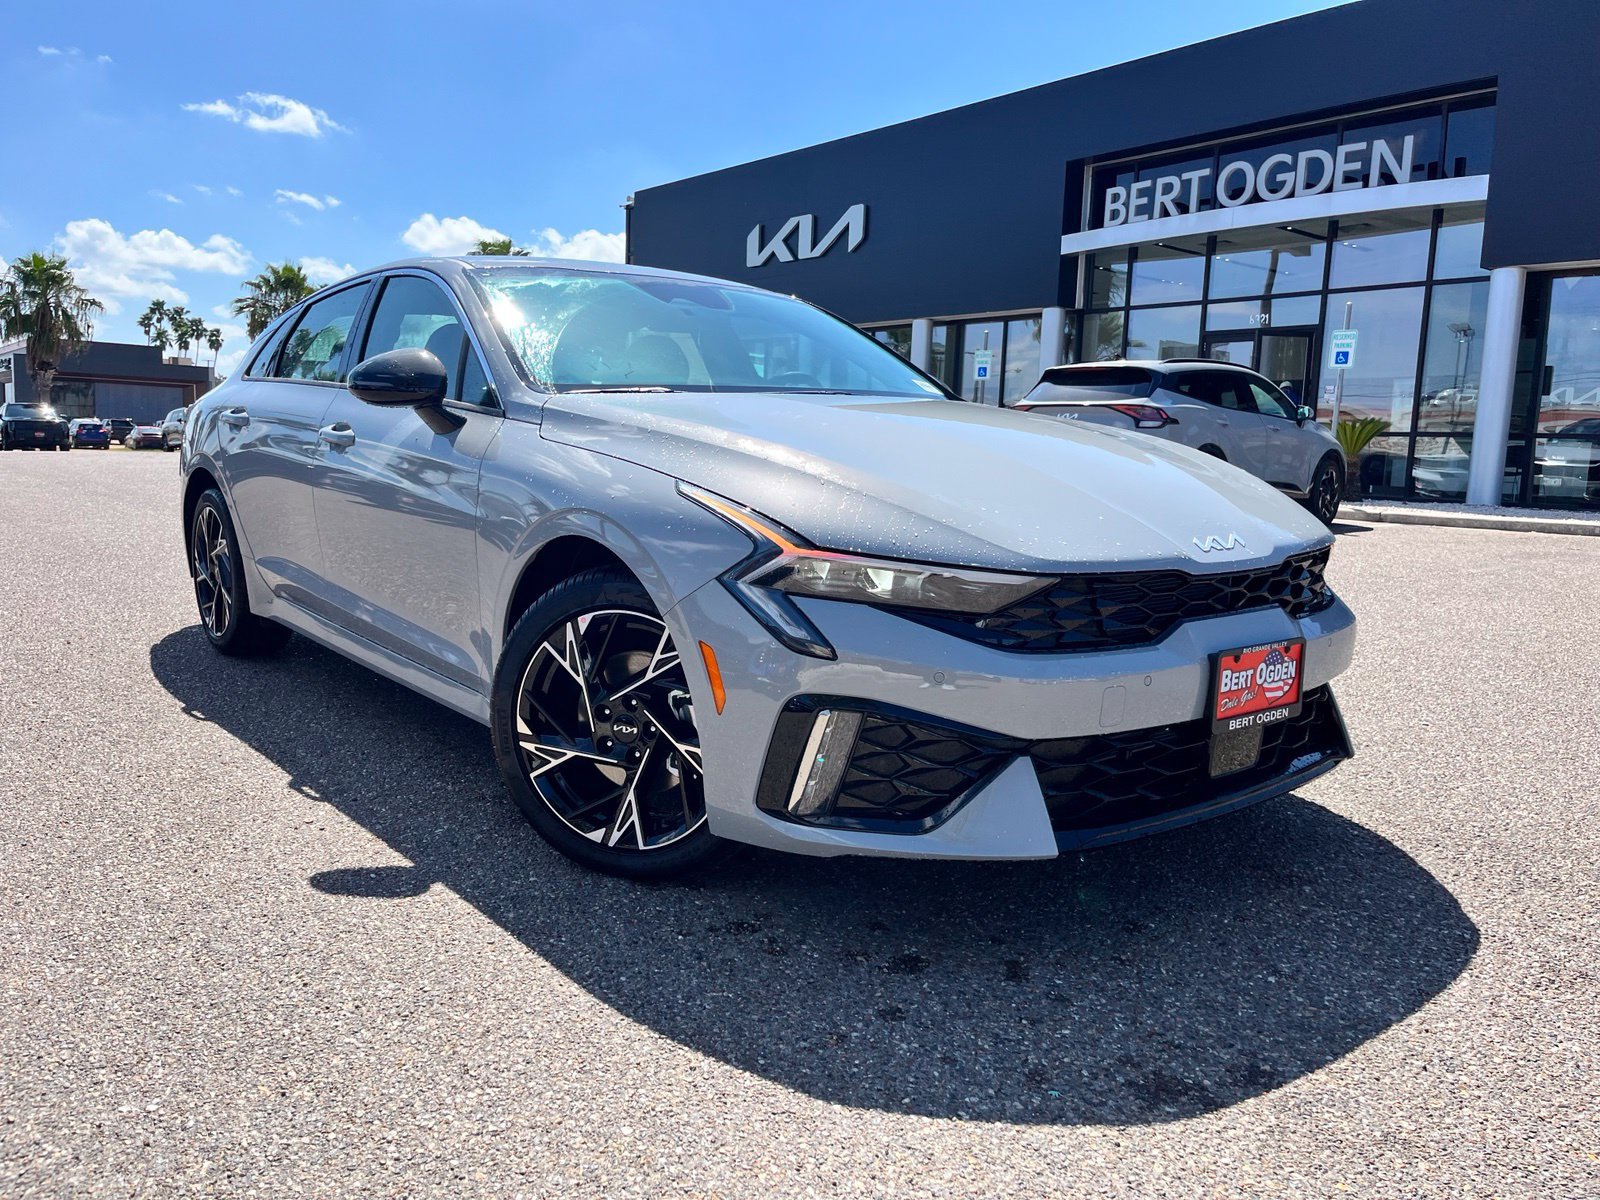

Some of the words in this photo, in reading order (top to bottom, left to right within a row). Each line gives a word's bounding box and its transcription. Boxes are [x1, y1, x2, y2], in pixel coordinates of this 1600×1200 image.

[1103, 167, 1210, 229] BERT
[1216, 135, 1414, 208] OGDEN
[746, 203, 865, 267] KIA
[1192, 532, 1246, 553] KIA
[1242, 647, 1252, 655] RIO
[1252, 644, 1271, 653] GRANDE
[1271, 641, 1288, 650] VALLEY
[1220, 669, 1254, 693] BERT
[1256, 660, 1297, 685] OGDEN
[1220, 697, 1239, 712] Dale
[1228, 715, 1255, 730] BERT
[1256, 707, 1289, 724] OGDEN
